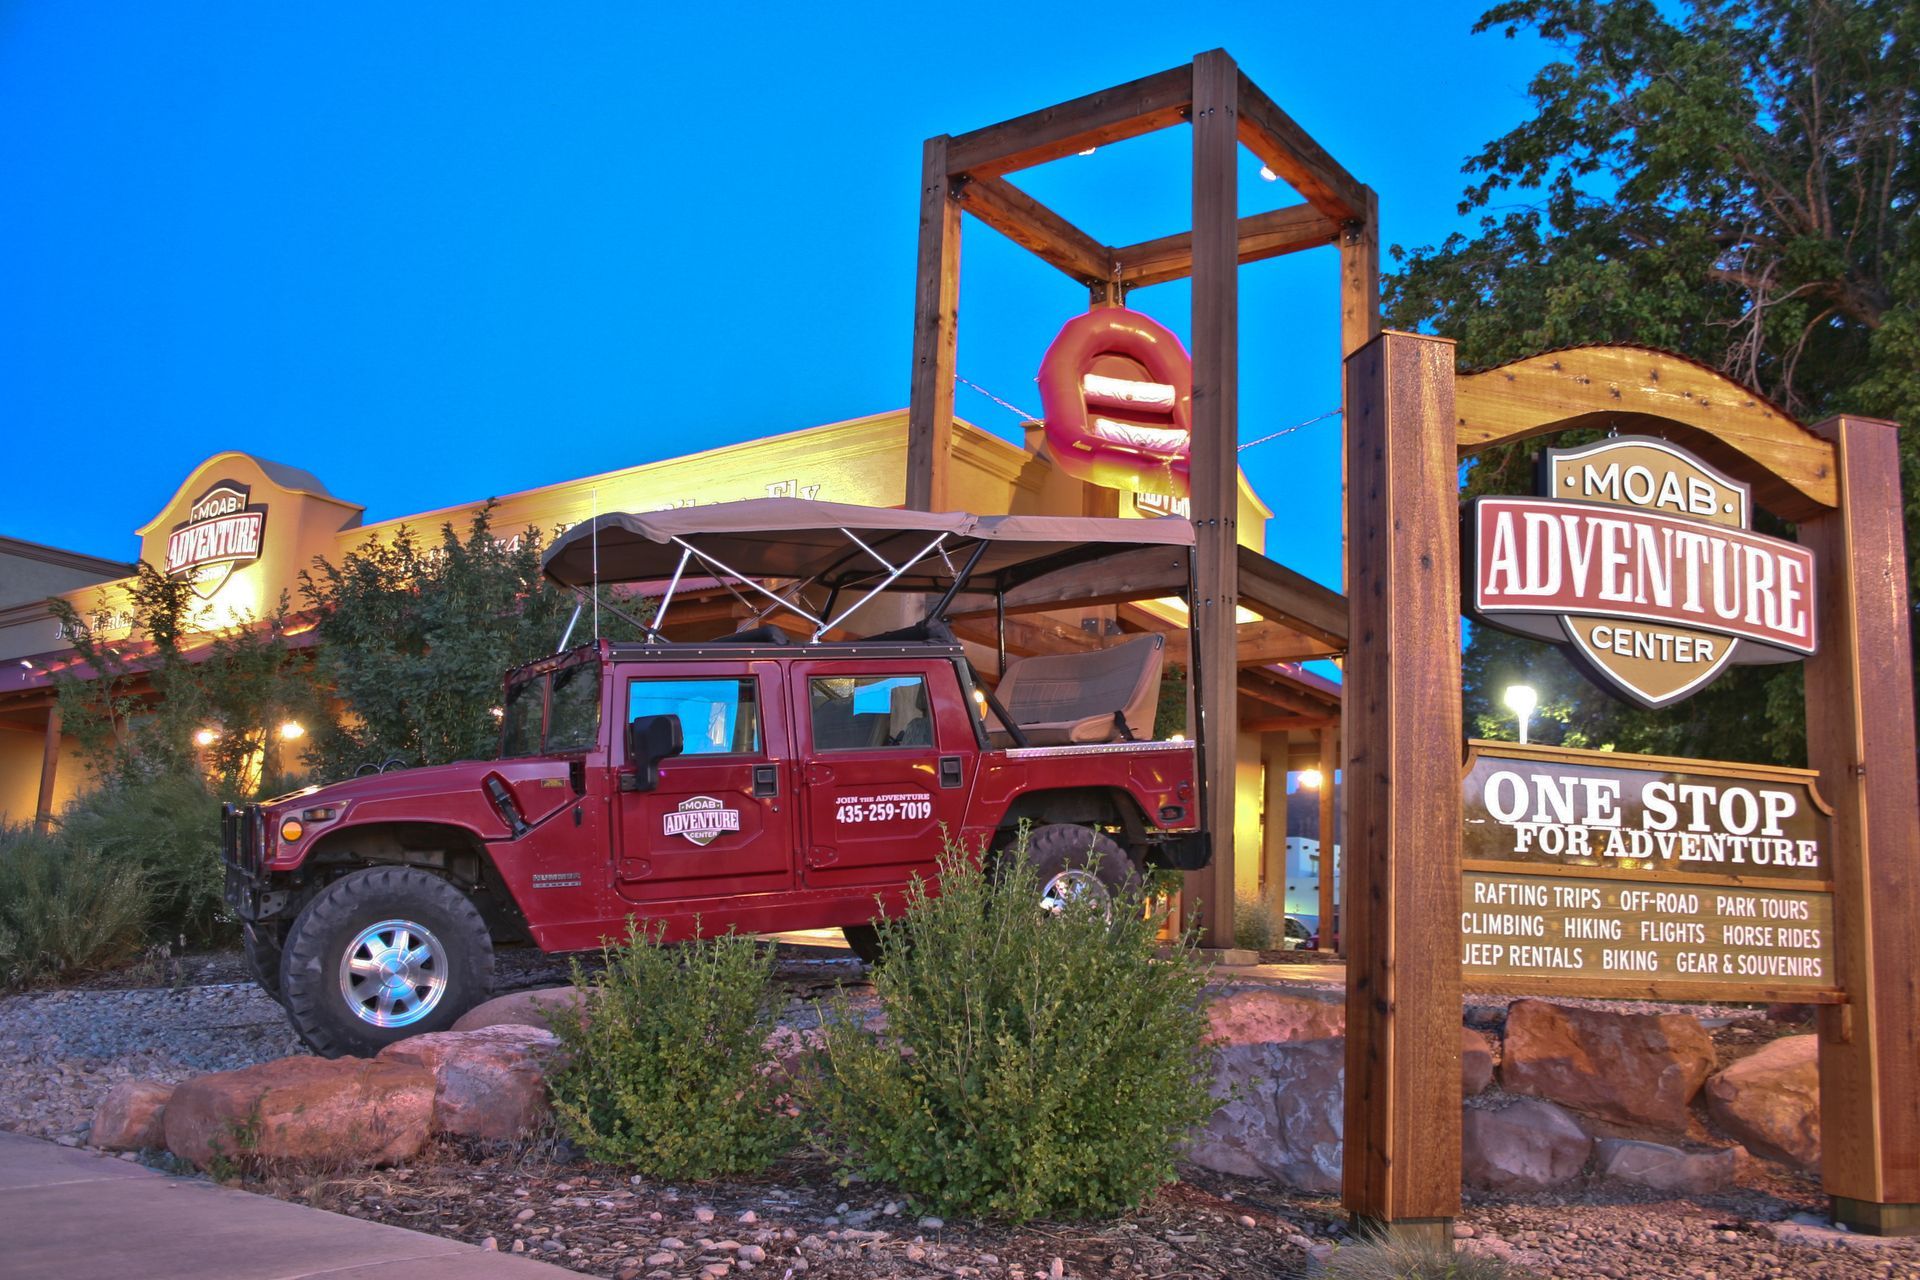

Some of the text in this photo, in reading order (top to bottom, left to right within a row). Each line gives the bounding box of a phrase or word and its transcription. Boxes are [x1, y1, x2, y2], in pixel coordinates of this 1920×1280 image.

[1584, 463, 1718, 516] MOAB
[198, 497, 238, 520] MOAB
[168, 517, 260, 569] ADVENTURE
[1484, 510, 1806, 637] ADVENTURE
[1591, 625, 1714, 663] CENTER
[685, 801, 716, 810] MOAB
[836, 796, 858, 805] JOIN
[876, 793, 930, 802] ADVENTURE
[836, 802, 931, 824] 435-259-7019
[1483, 770, 1797, 837] ONE STOP
[667, 812, 737, 833] ADVENTURE
[690, 831, 718, 839] CENTER
[1513, 823, 1818, 867] FOR ADVENTURE
[1474, 882, 1808, 920] RAFTING TRIPS OFF-ROAD PARK TOURS
[1461, 912, 1821, 949] CLIMBING HIKING FLIGHTS HORSE RIDES
[1461, 943, 1822, 977] JEEP RENTALS BIKING GEAR & SOUVENIRS
